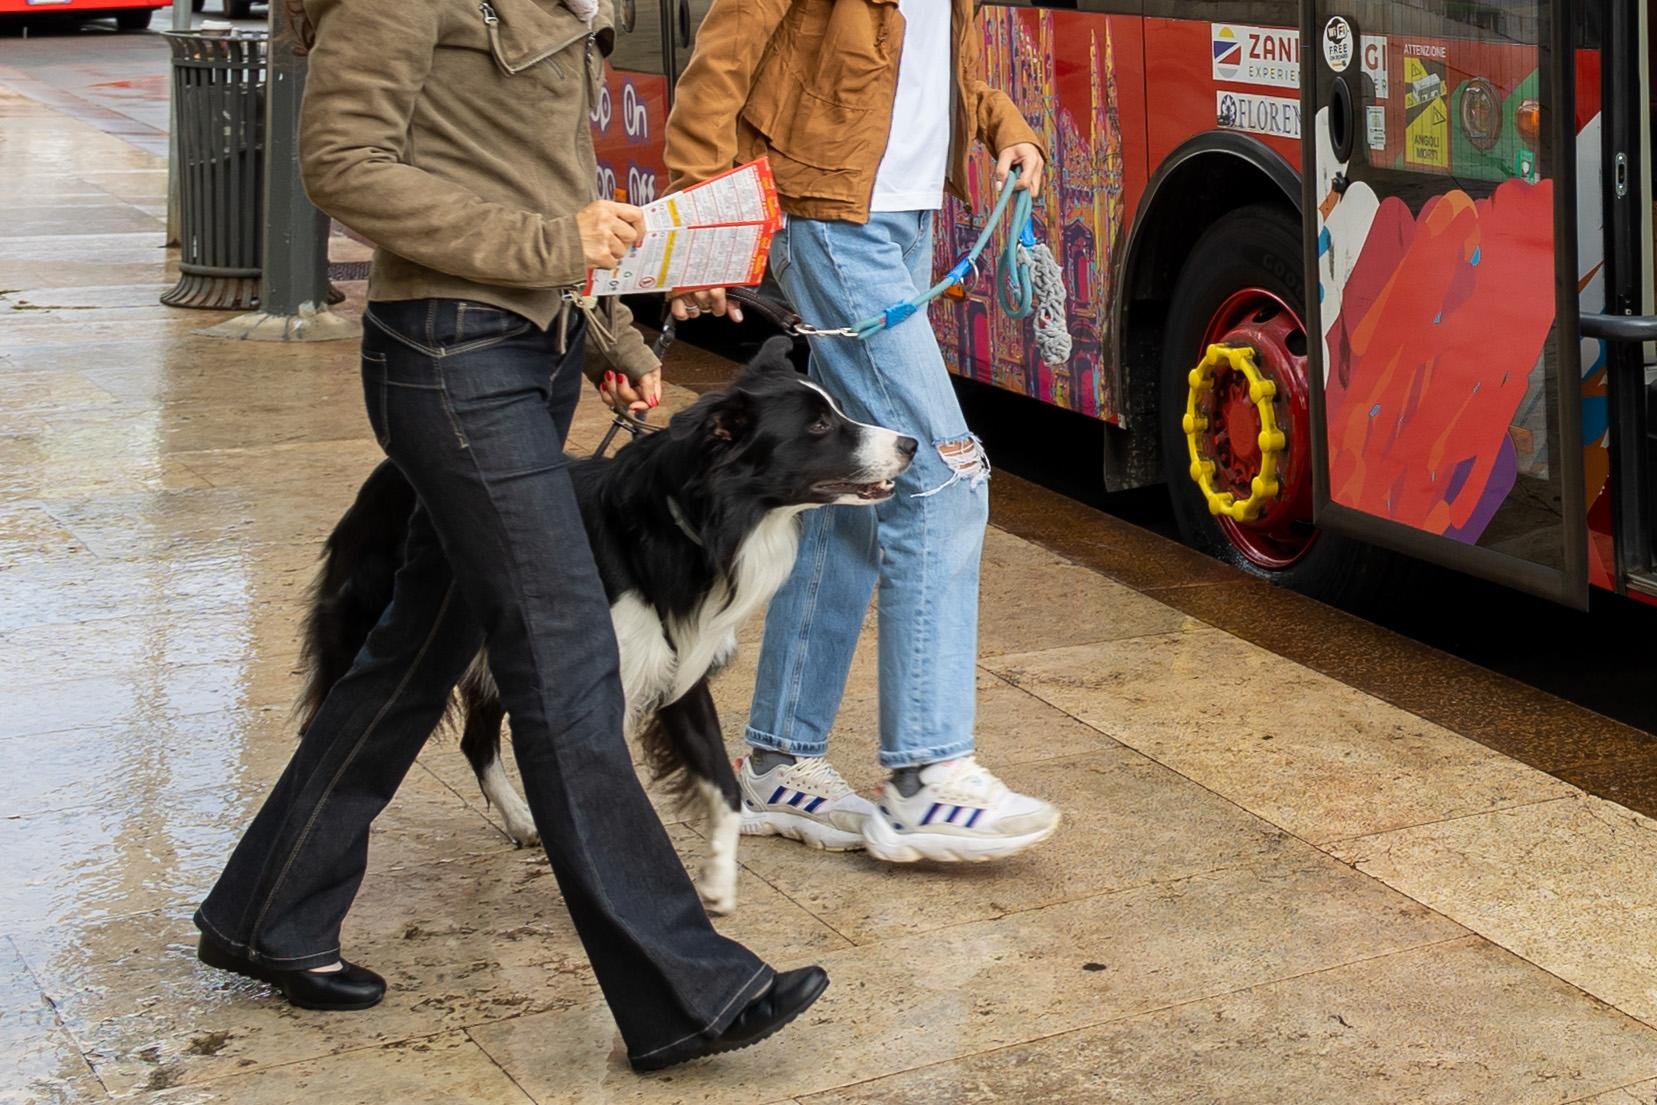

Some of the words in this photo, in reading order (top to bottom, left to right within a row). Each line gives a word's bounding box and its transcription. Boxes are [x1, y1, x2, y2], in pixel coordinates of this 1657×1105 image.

[1329, 43, 1348, 55] FREE
[1403, 44, 1447, 58] ATTENZIONE
[1414, 135, 1440, 148] ANGOLI
